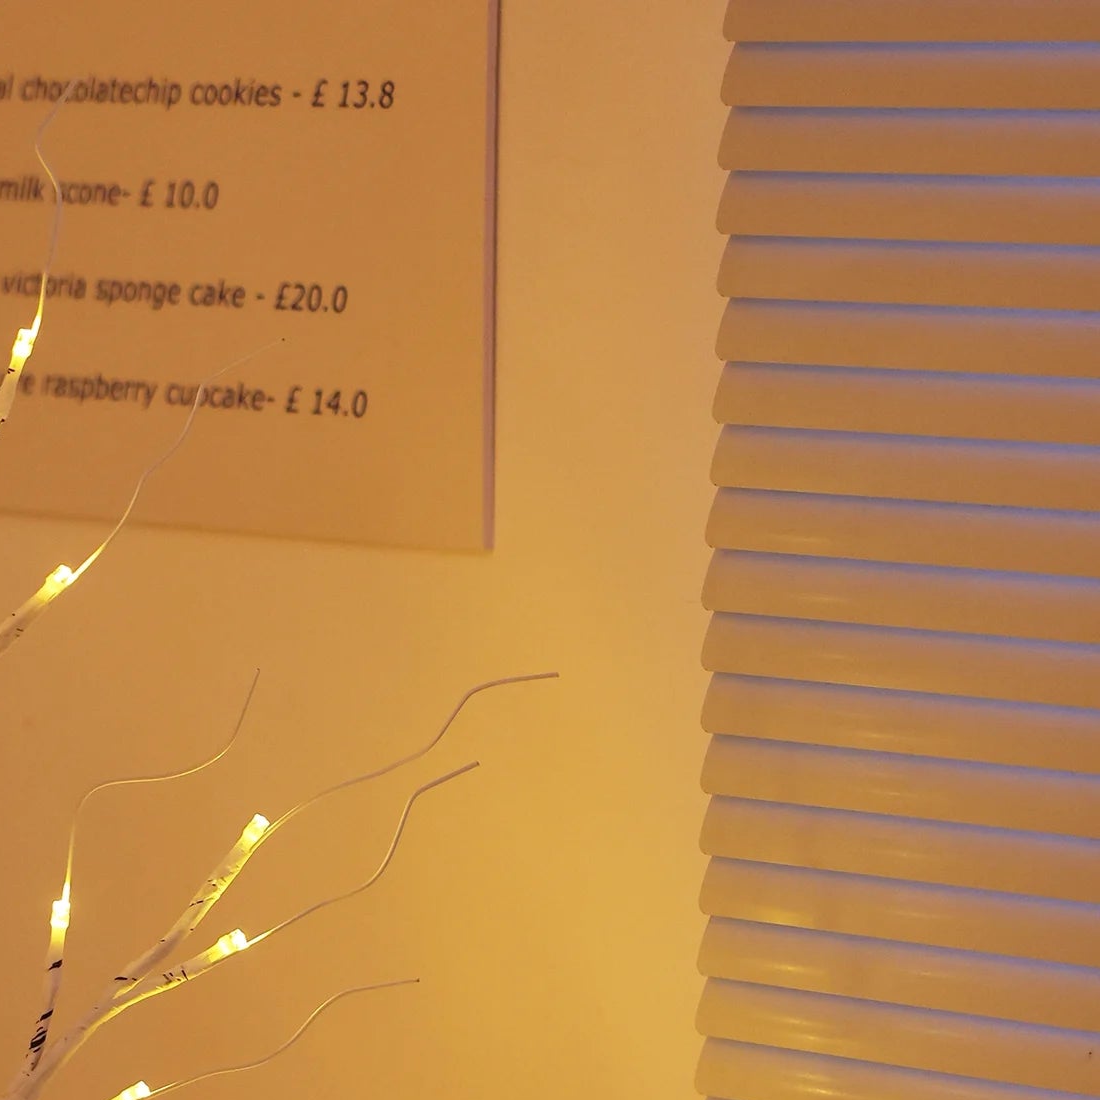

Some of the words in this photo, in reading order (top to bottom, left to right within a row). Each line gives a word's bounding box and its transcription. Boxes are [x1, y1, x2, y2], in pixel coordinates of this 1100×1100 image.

[190, 76, 283, 107] cookies
[310, 78, 329, 108] £
[338, 79, 396, 110] 13.8
[138, 178, 156, 208] £
[164, 180, 220, 210] 10.0
[95, 278, 181, 311] sponge
[189, 279, 246, 309] cake
[274, 281, 349, 314] £20.0
[43, 372, 158, 409] raspberry
[285, 385, 302, 414] £
[311, 387, 369, 419] 14.0
